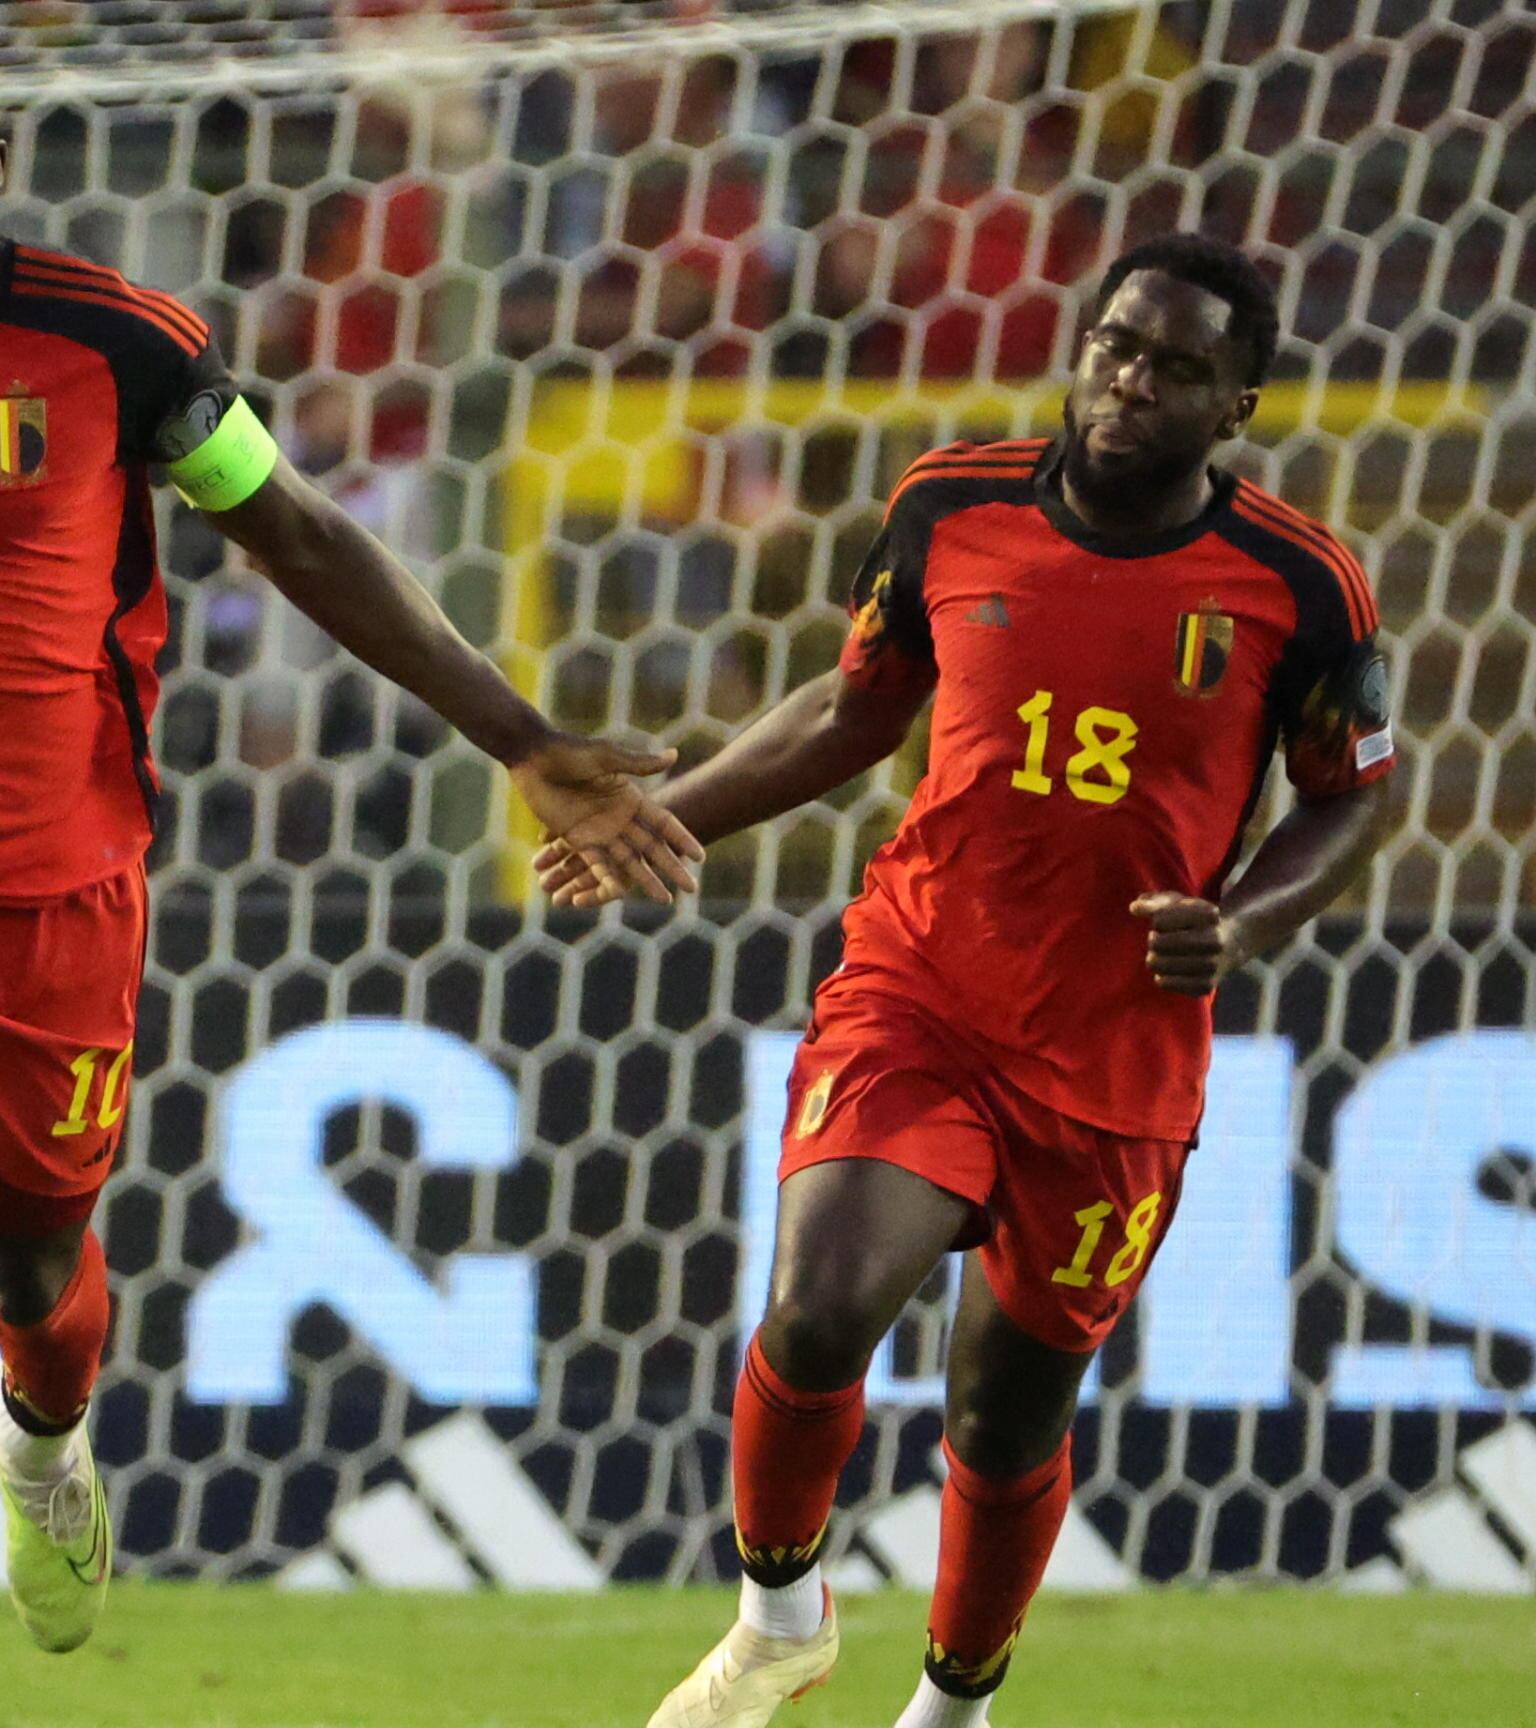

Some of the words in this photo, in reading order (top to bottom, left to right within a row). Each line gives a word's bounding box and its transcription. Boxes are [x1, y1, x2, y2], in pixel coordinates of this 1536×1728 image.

[1011, 690, 1139, 805] 18
[186, 1015, 540, 1406] &
[1051, 1191, 1161, 1288] 18
